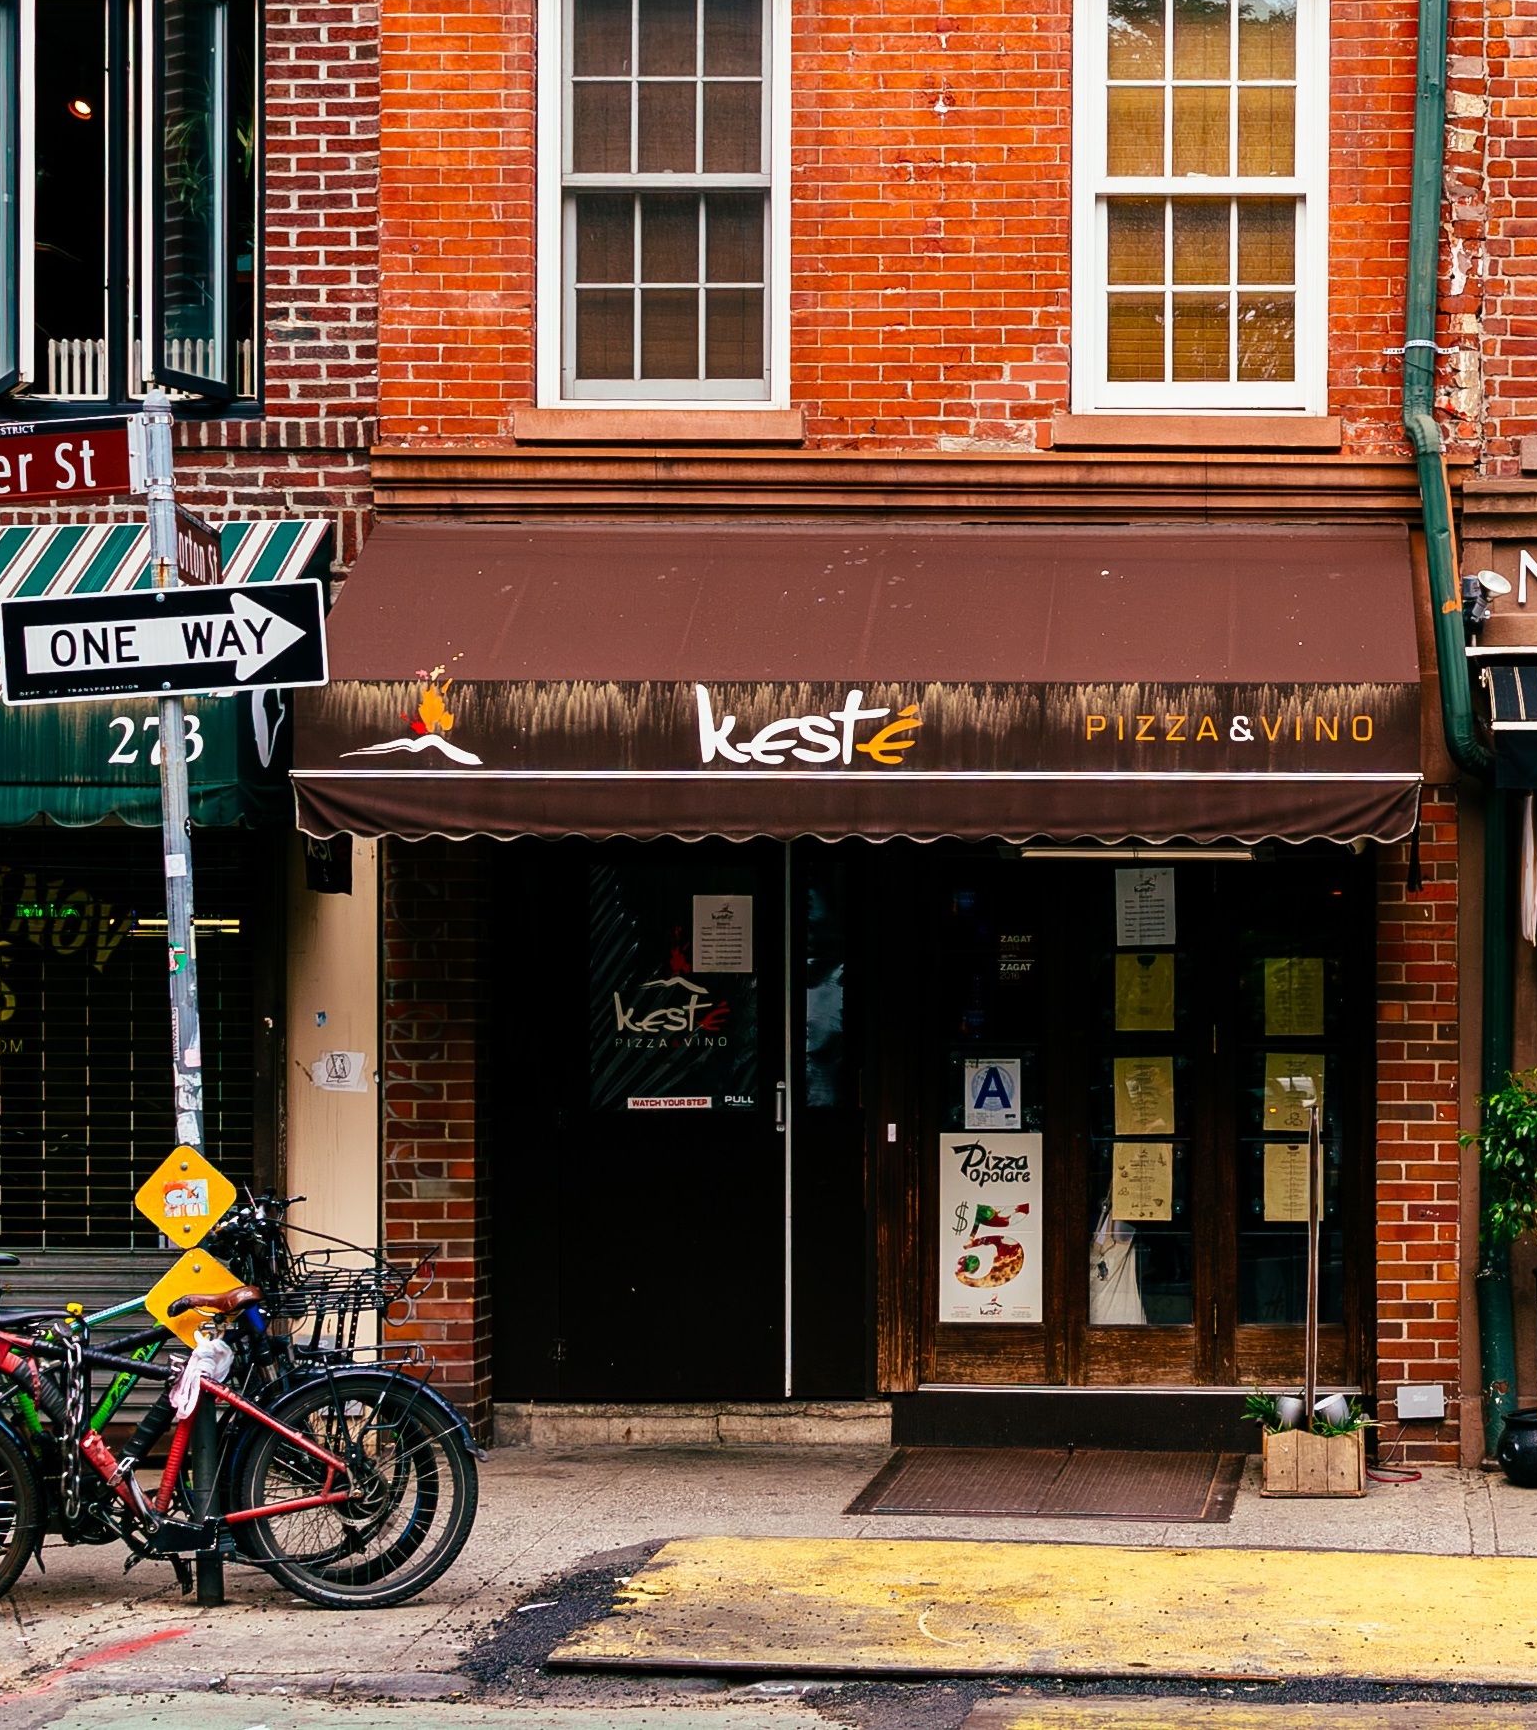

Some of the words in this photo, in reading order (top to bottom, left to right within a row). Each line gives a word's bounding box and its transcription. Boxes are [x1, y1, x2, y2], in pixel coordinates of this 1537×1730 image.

[55, 439, 97, 490] St
[178, 529, 206, 583] orton
[50, 625, 140, 668] ONE
[181, 616, 274, 660] WAY
[67, 684, 139, 694] TRANSPORTATION
[1000, 935, 1033, 943] ZAGAT
[999, 963, 1032, 971] ZAGAT
[724, 1095, 755, 1104] PULL
[974, 1066, 1012, 1109] A
[632, 1099, 661, 1107] WATCH
[663, 1099, 685, 1107] YOUR
[687, 1098, 708, 1106] STEP
[950, 1138, 1029, 1178] Pizza
